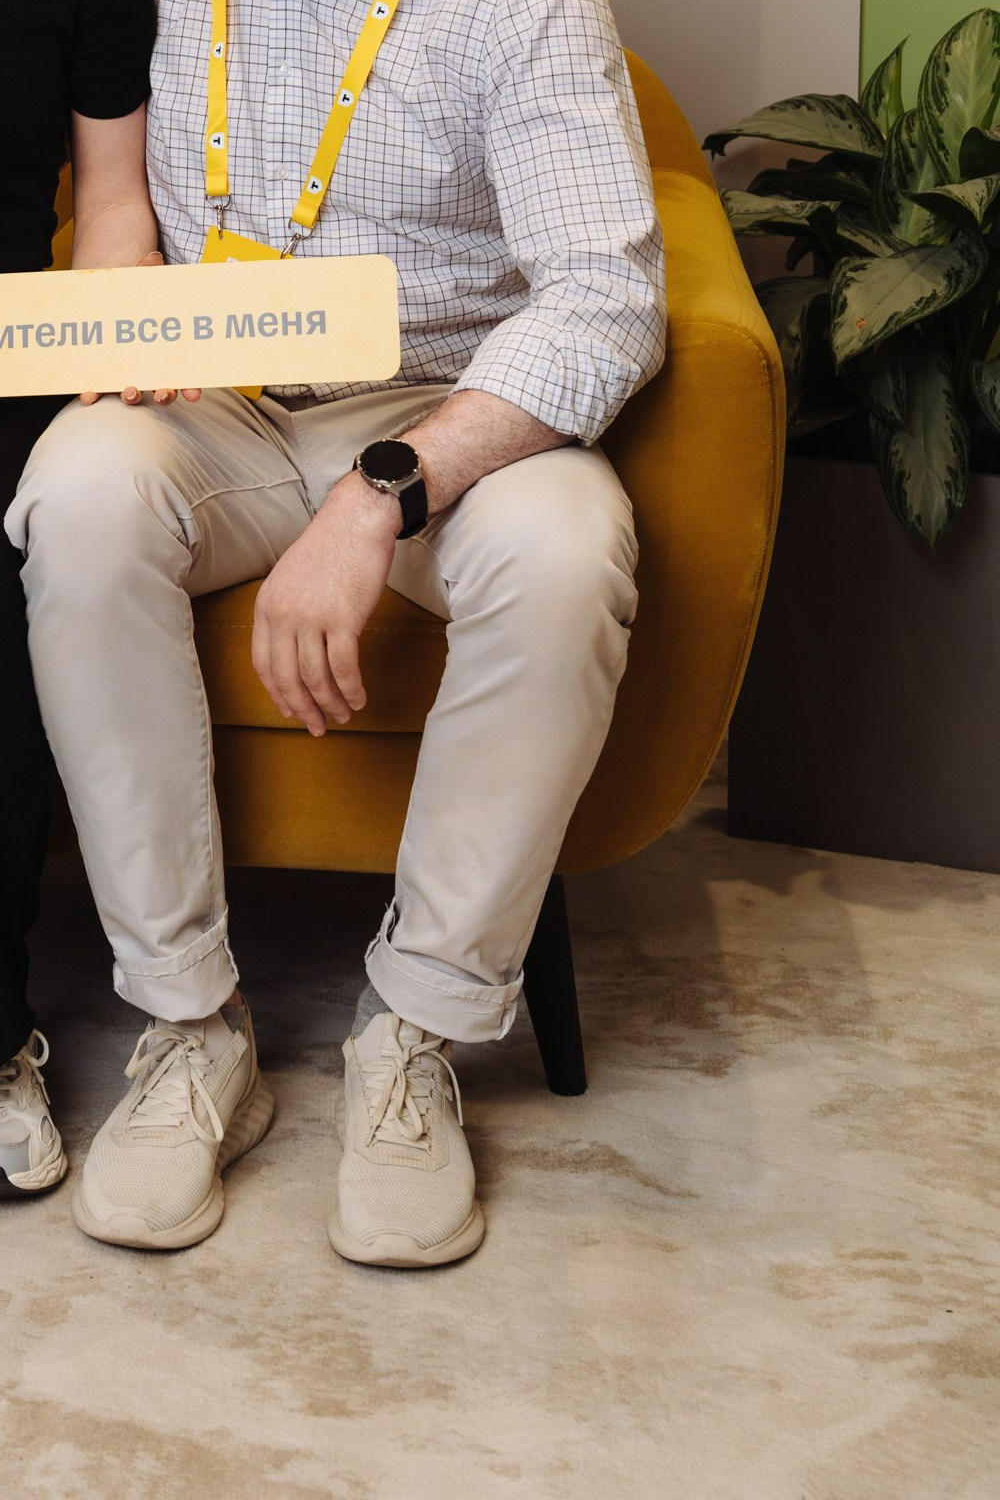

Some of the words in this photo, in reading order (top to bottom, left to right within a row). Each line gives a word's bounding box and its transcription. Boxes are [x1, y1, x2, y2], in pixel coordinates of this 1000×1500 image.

[115, 315, 182, 344] все
[193, 314, 214, 341] в
[225, 309, 327, 339] меня
